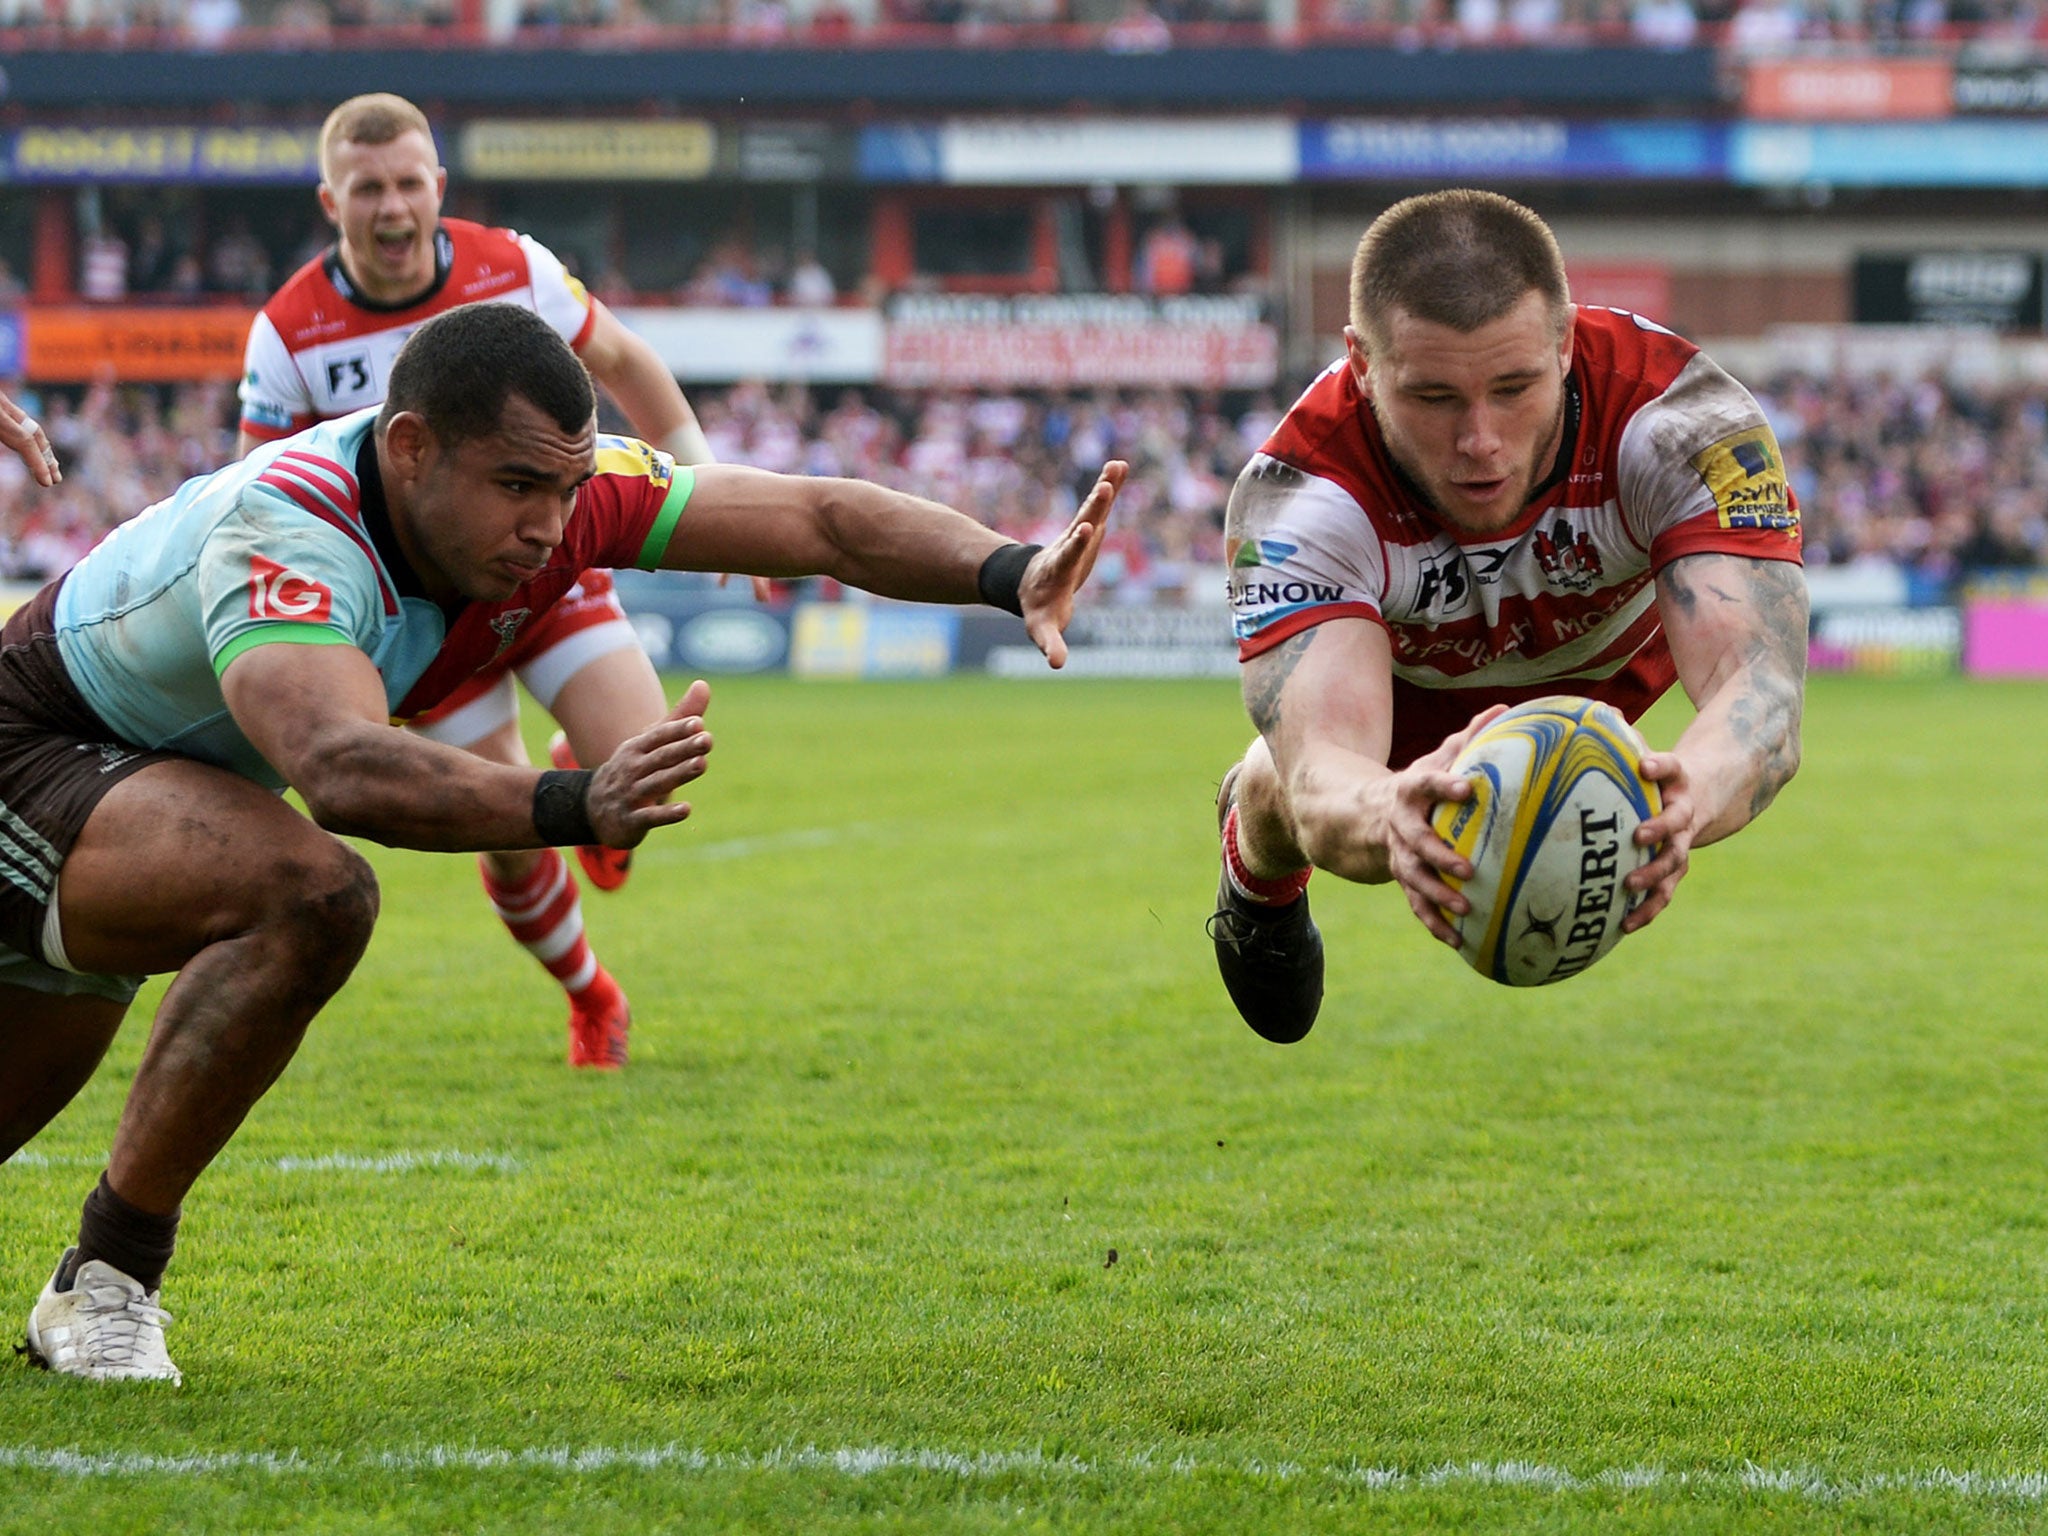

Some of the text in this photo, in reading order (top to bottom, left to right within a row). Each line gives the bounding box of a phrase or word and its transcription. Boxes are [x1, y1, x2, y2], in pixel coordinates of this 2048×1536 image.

[327, 357, 370, 393] F3
[254, 568, 321, 617] IG
[1549, 809, 1619, 980] ILBERT
